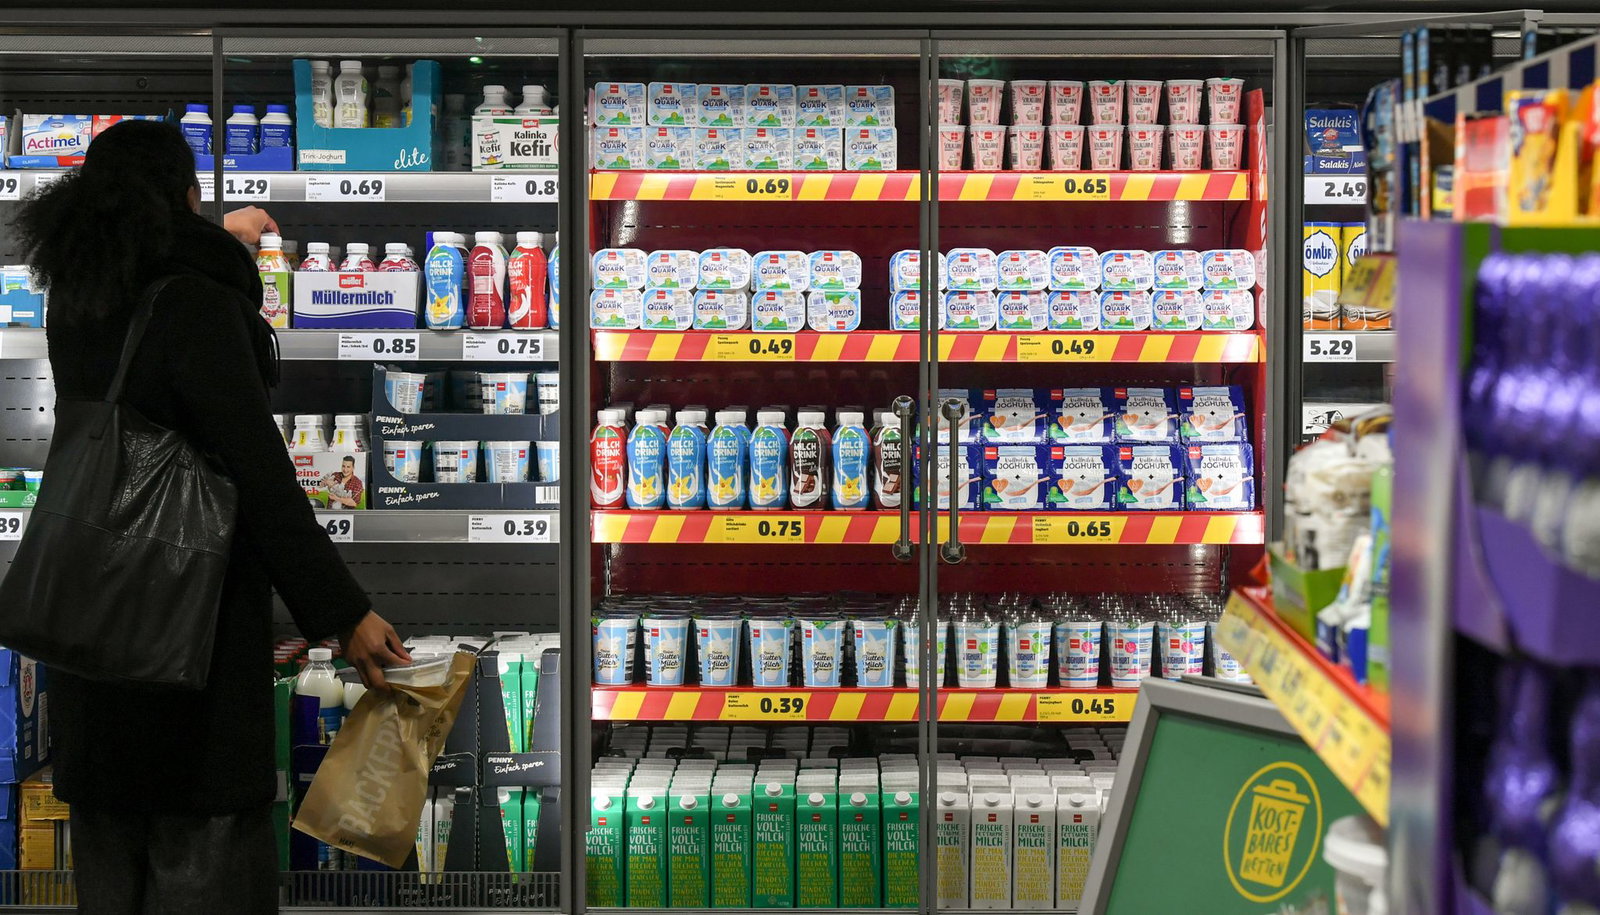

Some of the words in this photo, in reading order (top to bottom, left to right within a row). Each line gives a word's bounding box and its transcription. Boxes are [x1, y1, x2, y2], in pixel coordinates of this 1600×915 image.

[1310, 117, 1352, 128] Salakis
[514, 131, 547, 139] Kalinka
[27, 134, 81, 150] Actimel
[480, 144, 502, 154] Kefir
[510, 140, 552, 156] Kefir
[394, 147, 429, 170] elite
[1320, 160, 1349, 168] Salakis
[226, 180, 268, 195] 1.29
[340, 180, 383, 195] 0.69
[526, 180, 559, 196] 0.8
[746, 178, 790, 194] 0.69
[1064, 179, 1106, 194] 0.65
[1324, 182, 1367, 197] 2.49
[430, 260, 454, 268] MILCH
[430, 268, 454, 276] DRINK
[312, 290, 394, 305] Müllermilch
[373, 338, 416, 354] 0.85
[498, 339, 540, 354] 0.75
[750, 339, 792, 354] 0.49
[1052, 340, 1094, 354] 0.49
[1310, 340, 1353, 356] 5.29
[382, 425, 410, 436] Einfach
[411, 423, 436, 434] sparen
[635, 440, 658, 448] MILCH
[671, 440, 693, 448] MILCH
[714, 440, 738, 448] MILCH
[794, 442, 816, 450] MILCH
[840, 441, 863, 449] MILCH
[635, 448, 659, 456] DRINK
[671, 448, 694, 456] DRINK
[714, 448, 738, 456] DRINK
[840, 449, 864, 457] DRINK
[999, 462, 1035, 470] JOGHURT
[1134, 462, 1170, 470] JOGHURT
[386, 494, 414, 506] Einfach
[416, 492, 440, 502] sparen
[504, 520, 548, 536] 0.39
[758, 520, 802, 536] 0.75
[1068, 521, 1111, 537] 0.65
[760, 698, 804, 714] 0.39
[1072, 698, 1114, 714] 0.45
[494, 764, 520, 774] Einfach
[522, 760, 544, 772] sparen
[757, 814, 784, 822] FRISCHE
[1252, 804, 1298, 833] KOST-
[714, 824, 742, 832] FRISCHE
[757, 822, 784, 832] VOLL-
[586, 835, 613, 845] VOLL-
[630, 835, 657, 845] VOLL-
[672, 835, 699, 845] VOLL-
[714, 832, 742, 842] VOLL-
[757, 832, 784, 841] MILCH
[800, 832, 828, 842] VOLL-
[843, 832, 870, 842] VOLL-
[888, 832, 914, 841] VOLL-
[976, 837, 1002, 846] MILCH
[715, 843, 742, 852] MILCH
[800, 842, 827, 851] MILCH
[843, 842, 870, 851] MILCH
[888, 841, 914, 850] MILCH
[1018, 838, 1045, 847] MILCH
[1061, 838, 1088, 847] MILCH
[1249, 830, 1293, 855] BARES
[586, 845, 613, 855] MILCH
[630, 845, 657, 854] MILCH
[672, 845, 699, 854] MILCH
[1243, 857, 1284, 877] RETTEN
